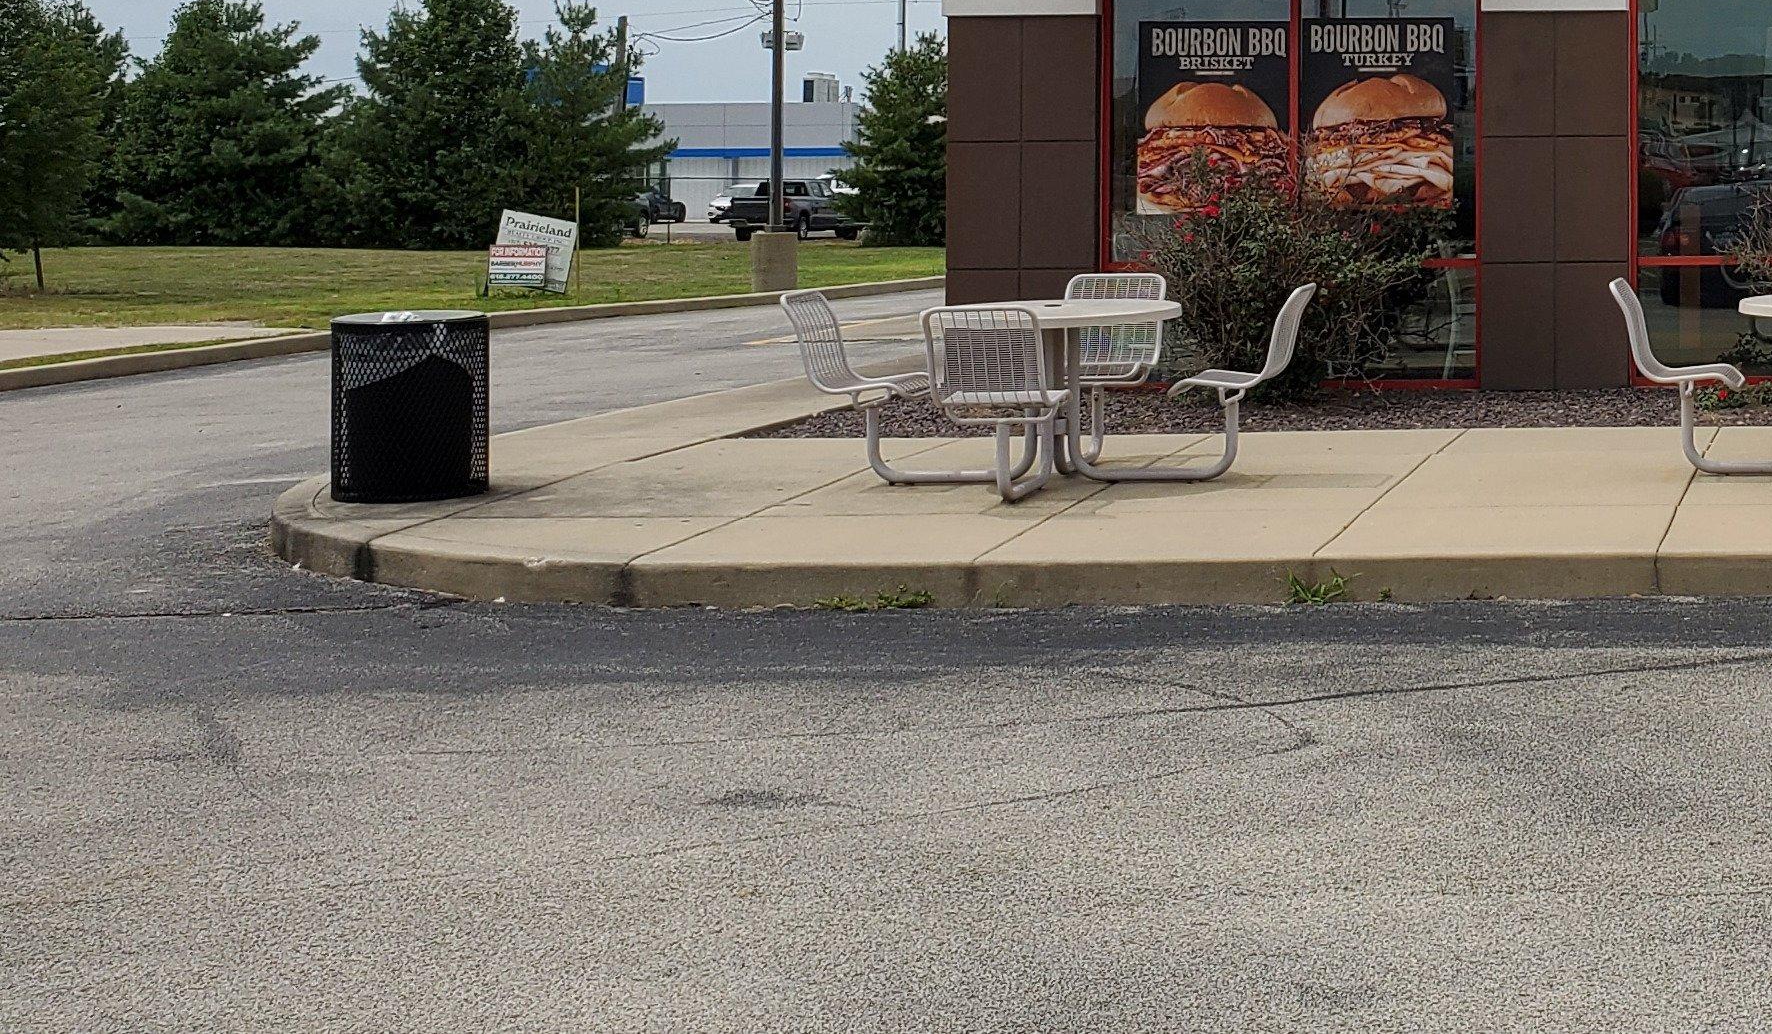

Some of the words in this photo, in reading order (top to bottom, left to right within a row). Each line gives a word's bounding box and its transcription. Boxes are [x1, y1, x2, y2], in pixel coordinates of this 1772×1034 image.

[1152, 28, 1242, 57] BOURBON
[1249, 27, 1287, 58] BBQ
[1310, 24, 1400, 53] BOURBON
[1406, 24, 1445, 54] BBQ
[1178, 56, 1255, 70] BRISKET
[1341, 53, 1416, 66] TURKEY
[505, 216, 573, 238] Prairieland
[505, 247, 546, 257] INFORMATION
